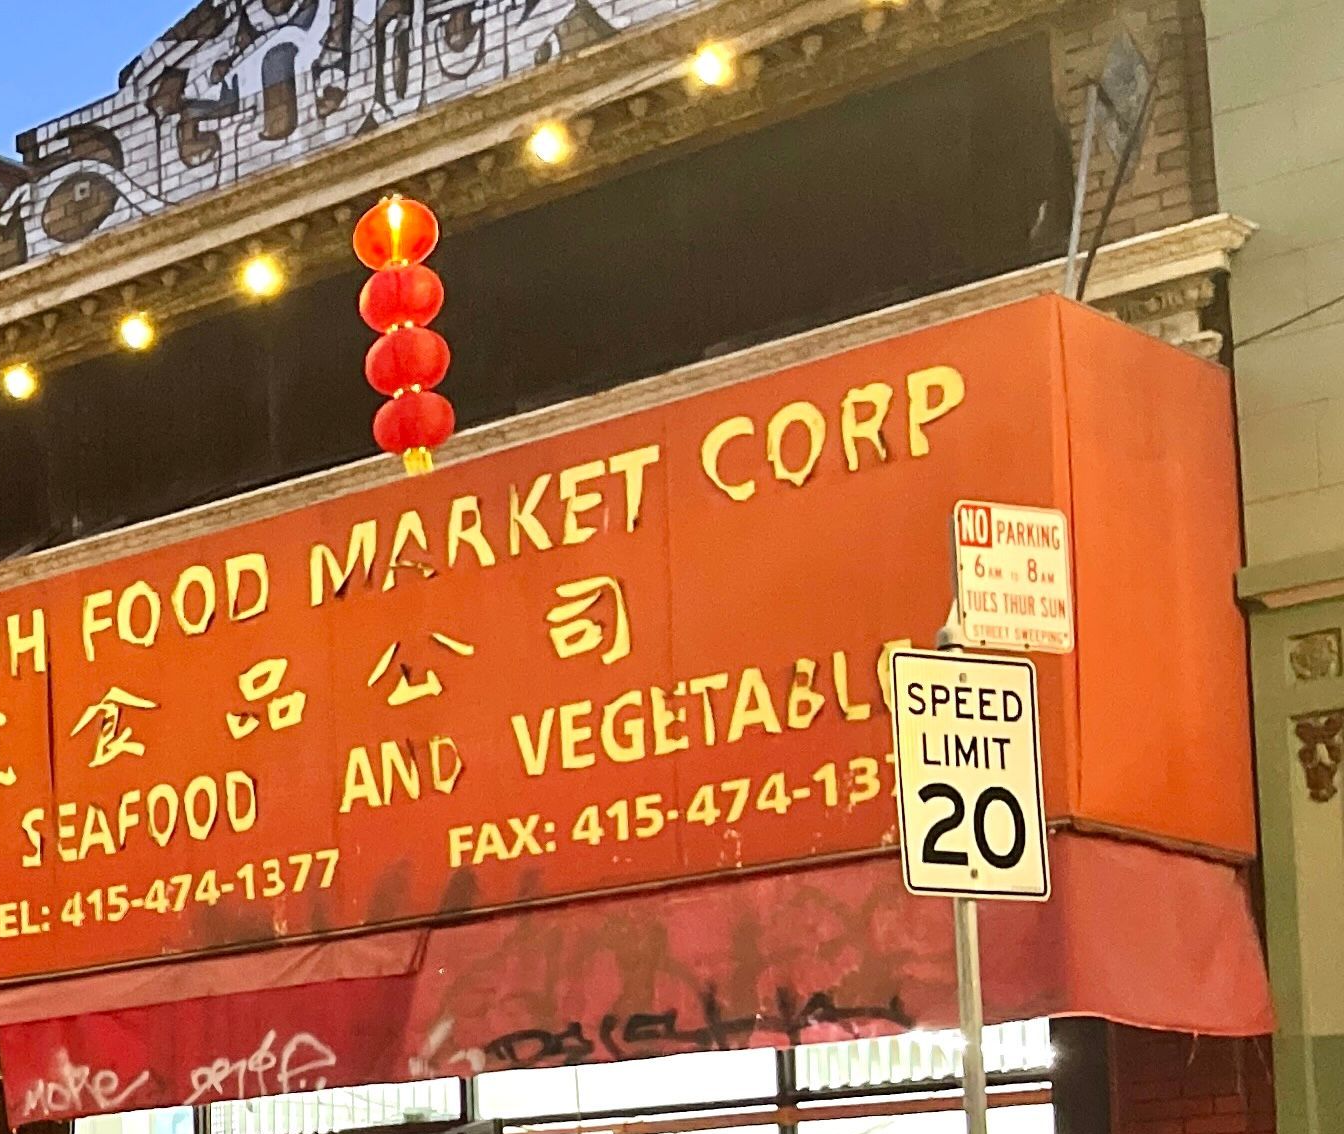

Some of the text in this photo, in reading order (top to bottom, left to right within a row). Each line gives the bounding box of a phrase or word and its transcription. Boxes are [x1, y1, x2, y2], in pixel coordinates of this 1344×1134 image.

[82, 552, 269, 662] FOOD
[310, 444, 660, 608] MARKET
[701, 364, 966, 502] CORP
[960, 507, 1061, 550] NO PARKING
[967, 590, 1066, 620] TUES THUR SUN
[906, 682, 1023, 724] SPEED
[921, 732, 1011, 771] LIMIT
[21, 769, 258, 869] SEAFOOD
[339, 735, 464, 814] AND
[917, 782, 1026, 870] 20
[61, 848, 341, 928] 415-474-1377
[448, 812, 557, 869] FAX:
